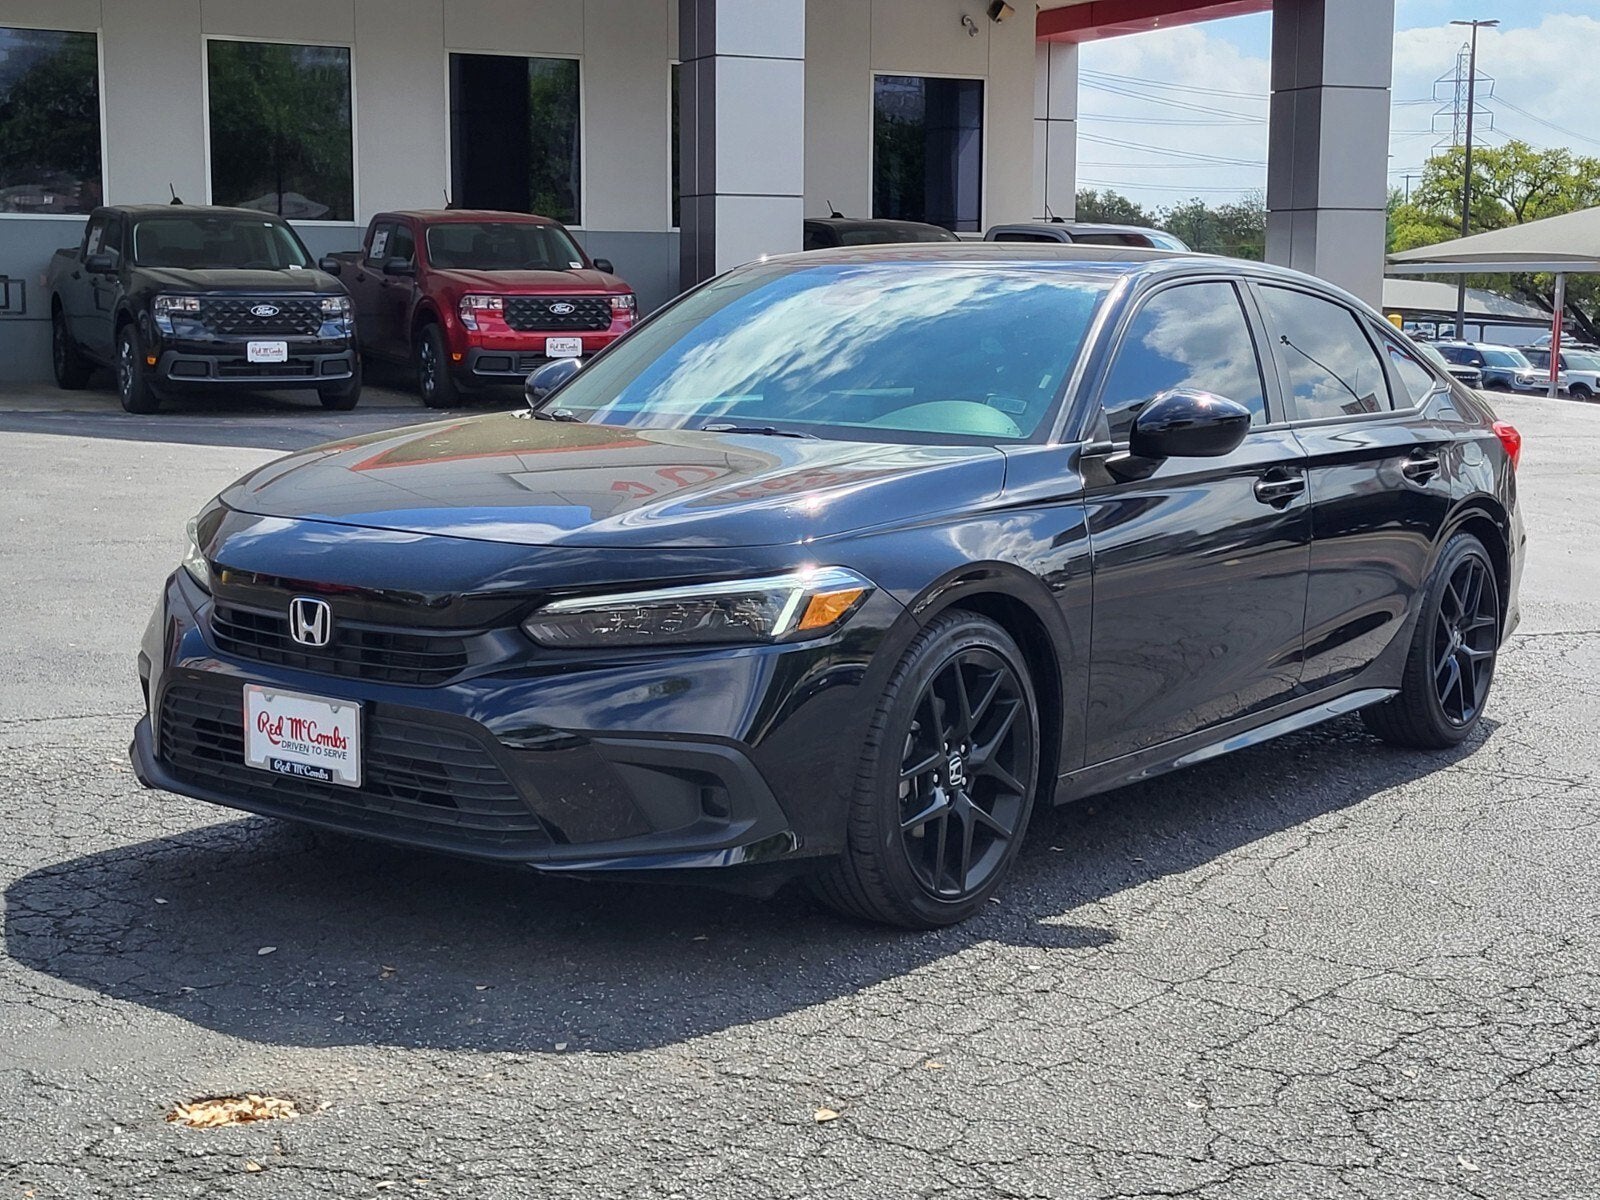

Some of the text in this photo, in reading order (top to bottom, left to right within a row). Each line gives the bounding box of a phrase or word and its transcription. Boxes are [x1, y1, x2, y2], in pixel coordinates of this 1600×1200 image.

[257, 711, 284, 745] Red
[281, 741, 348, 760] DRIVEN TO SERVE
[274, 759, 290, 773] Red
